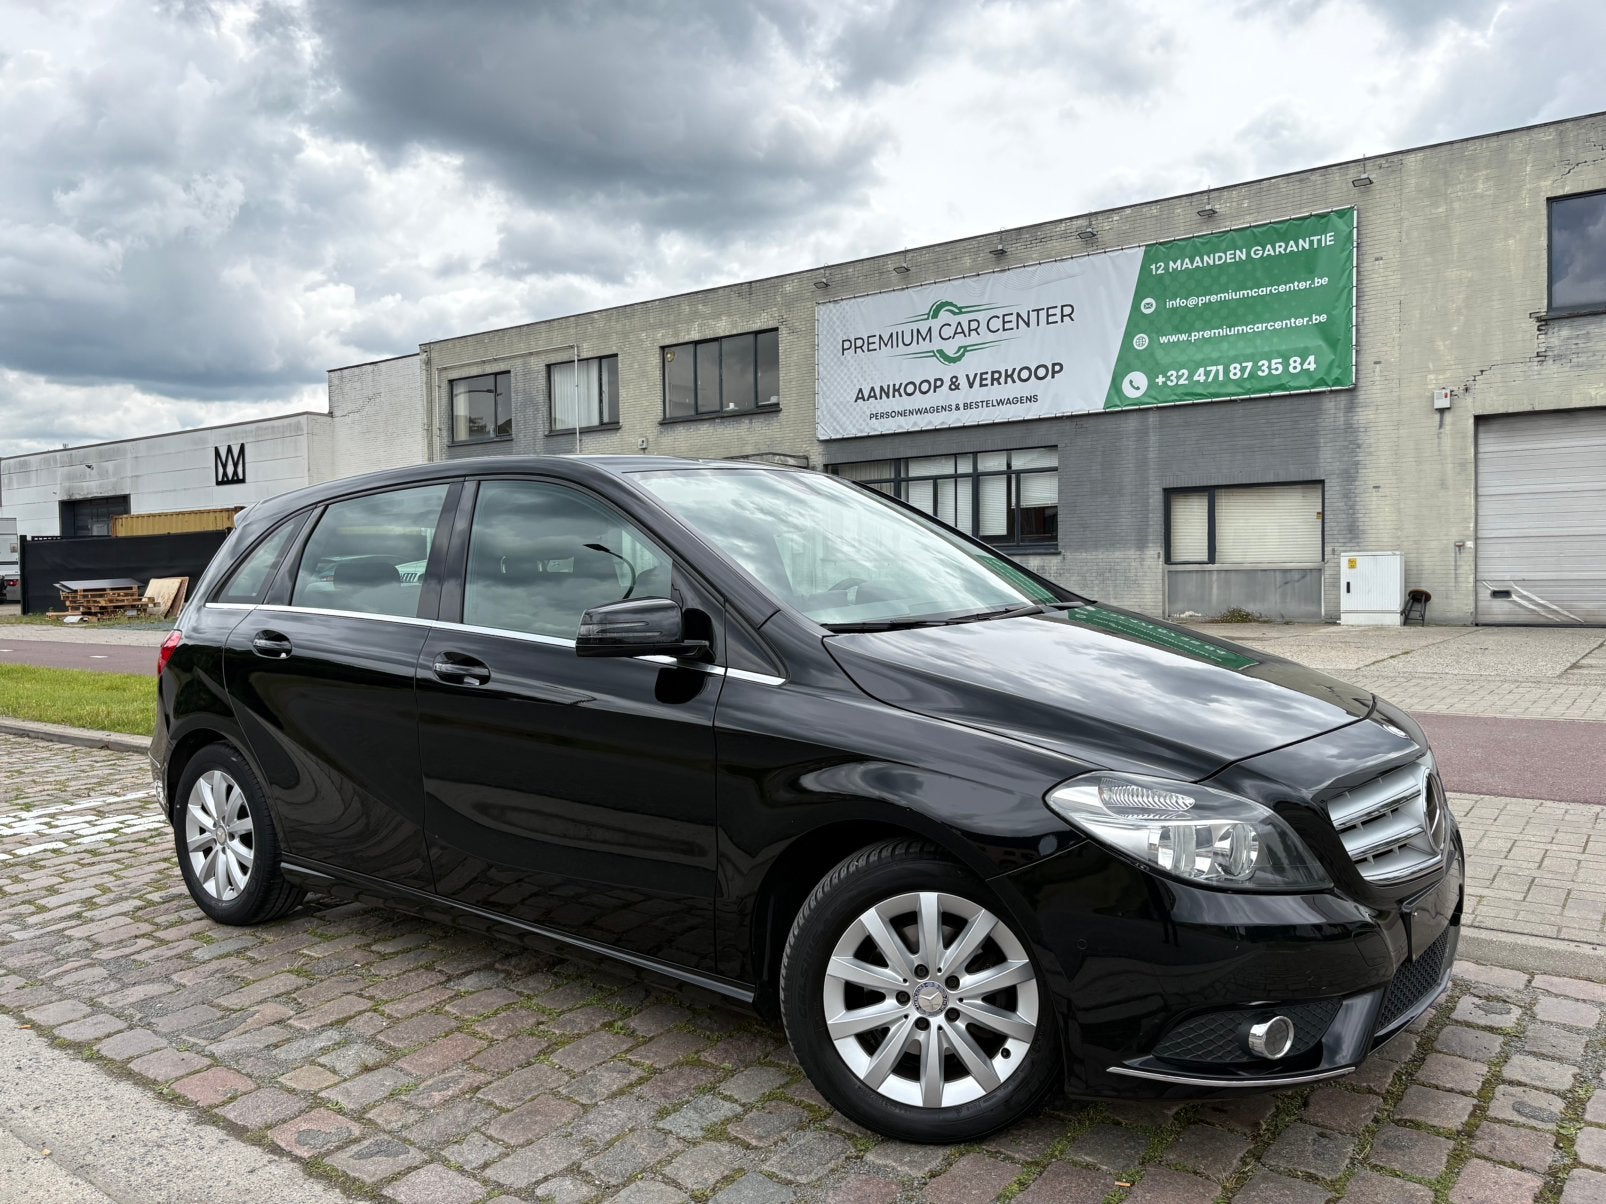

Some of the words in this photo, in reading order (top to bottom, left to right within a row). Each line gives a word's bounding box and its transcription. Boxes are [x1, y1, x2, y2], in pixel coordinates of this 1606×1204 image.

[1150, 262, 1165, 275] 12
[1169, 248, 1247, 272] MAANDEN
[1250, 232, 1335, 259] GARANTIE
[1166, 276, 1329, 309] info@premiumcarcenter.be
[841, 326, 932, 356] PREMIUM
[938, 318, 981, 341] CAR
[986, 303, 1075, 333] CENTER
[1159, 313, 1328, 344] www.premiumcarcenter.be
[854, 377, 944, 403] AANKOOP
[949, 375, 961, 391] &
[965, 362, 1064, 389] VERKOOP
[1155, 368, 1189, 387] +32
[1193, 365, 1224, 383] 471
[1229, 361, 1253, 380] 87
[1257, 358, 1283, 377] 35
[1288, 354, 1317, 373] 84
[869, 404, 953, 421] PERSONENWAGENS
[954, 402, 961, 412] &
[962, 394, 1039, 410] BESTELWAGENS
